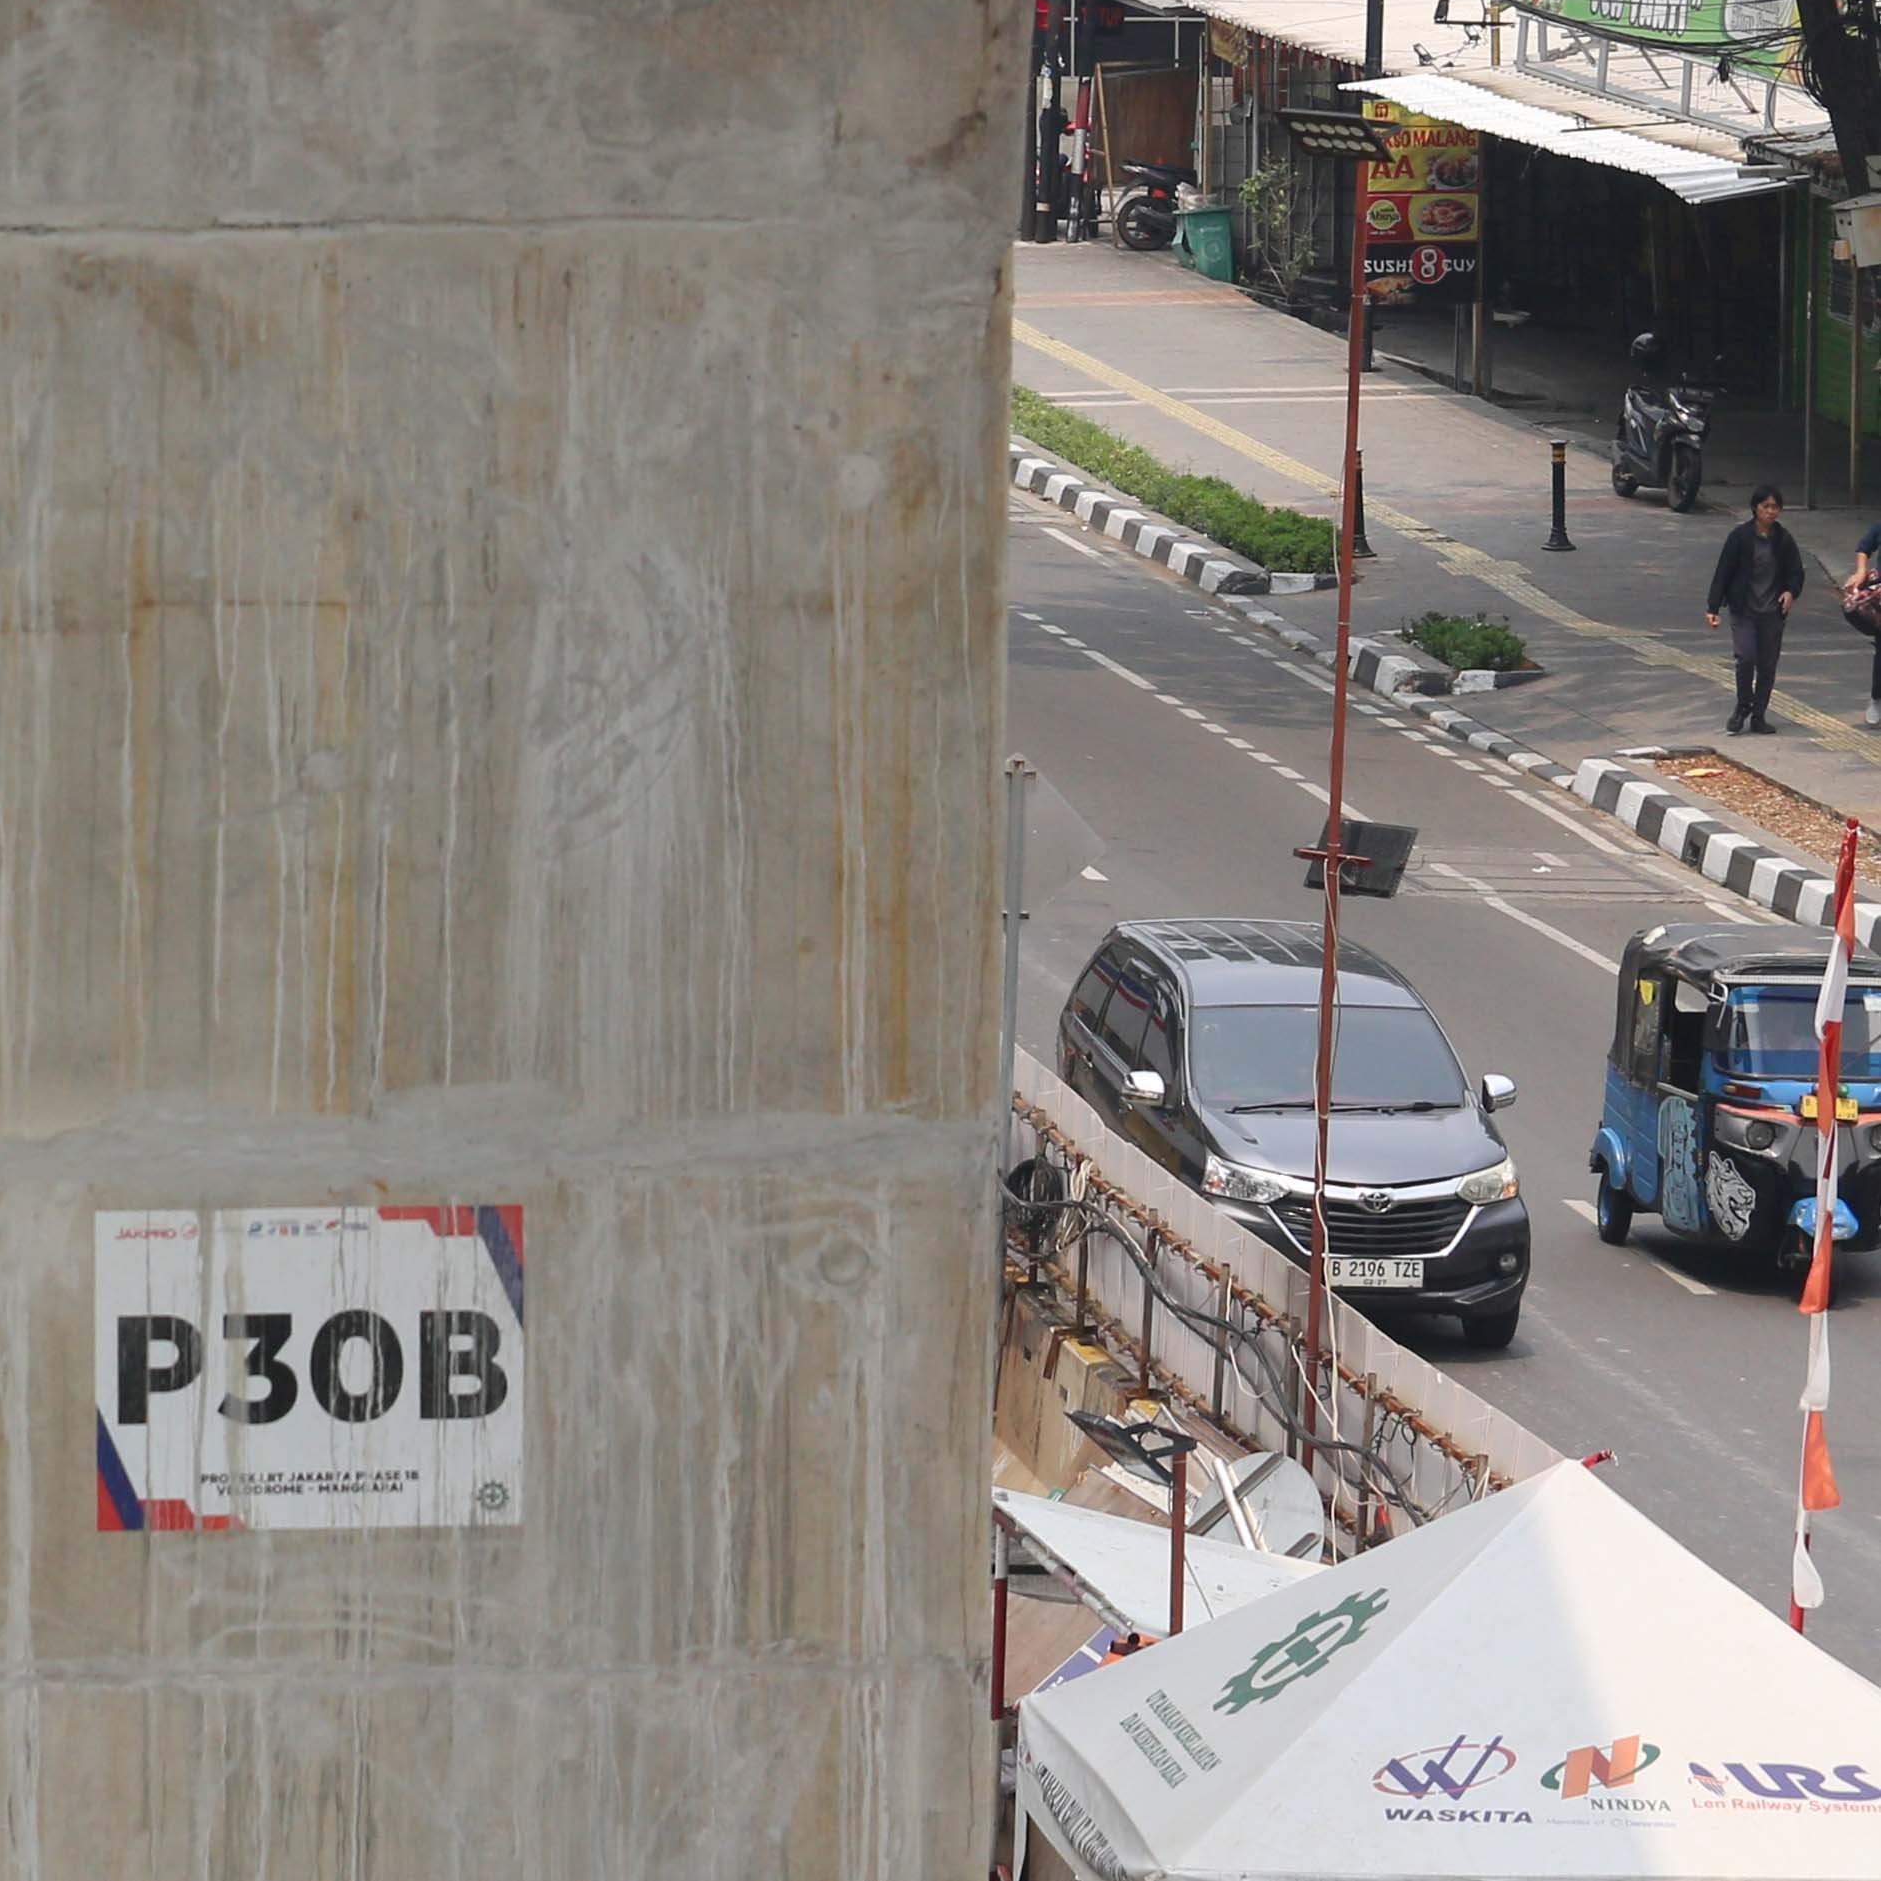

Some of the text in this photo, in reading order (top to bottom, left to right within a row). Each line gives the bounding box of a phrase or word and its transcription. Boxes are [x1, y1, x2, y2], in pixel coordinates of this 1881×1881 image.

[1413, 129, 1477, 148] MALANG
[1363, 259, 1413, 273] SUSHI
[1332, 1261, 1421, 1278] B 2196 TZE
[117, 1309, 509, 1426] P30B
[200, 1473, 255, 1484] PROEK
[356, 1470, 400, 1481] PASE
[217, 1484, 303, 1495] VEODROME
[1590, 1798, 1672, 1812] NINDYA
[1692, 1797, 1726, 1810] Len
[1731, 1797, 1802, 1813] Railway
[1385, 1808, 1533, 1824] WASKITA
